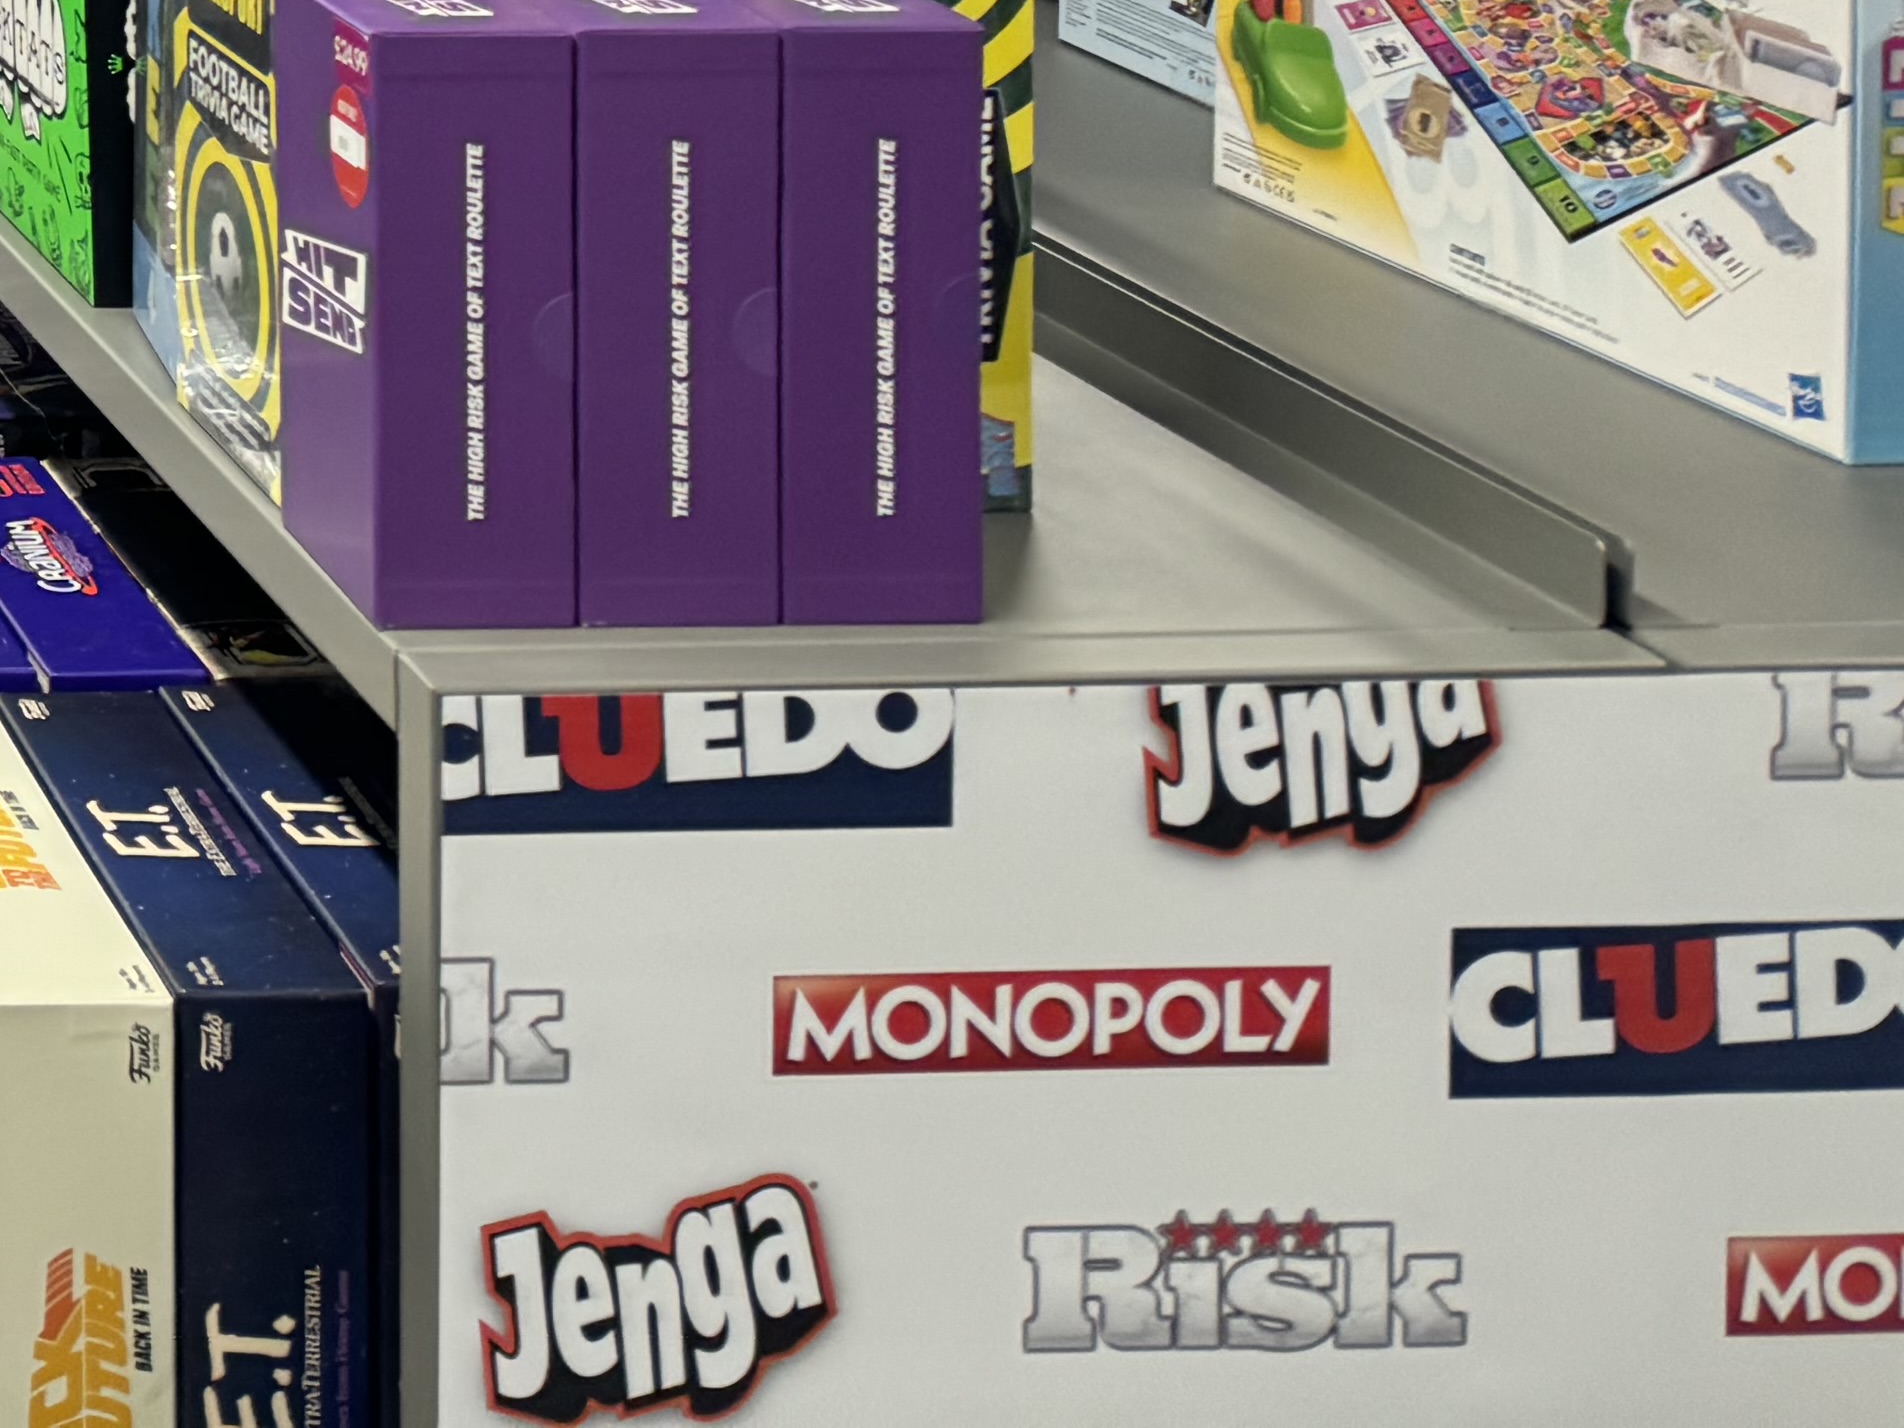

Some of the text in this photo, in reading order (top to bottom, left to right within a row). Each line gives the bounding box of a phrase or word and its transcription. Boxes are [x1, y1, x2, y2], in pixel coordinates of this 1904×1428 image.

[189, 38, 269, 125] FOOTBALL
[189, 71, 269, 156] TRIVIA GAME
[290, 233, 362, 303] HIT
[466, 143, 485, 521] THE HIGH RISK GAME OF TEXT ROULETTE
[1157, 679, 1491, 836] Jenga
[87, 799, 201, 860] E.T.
[784, 977, 1322, 1064] MONOPOLY
[1450, 929, 1904, 1064] CLUED
[491, 1185, 822, 1402] Jenga
[1023, 1218, 1467, 1352] Risk
